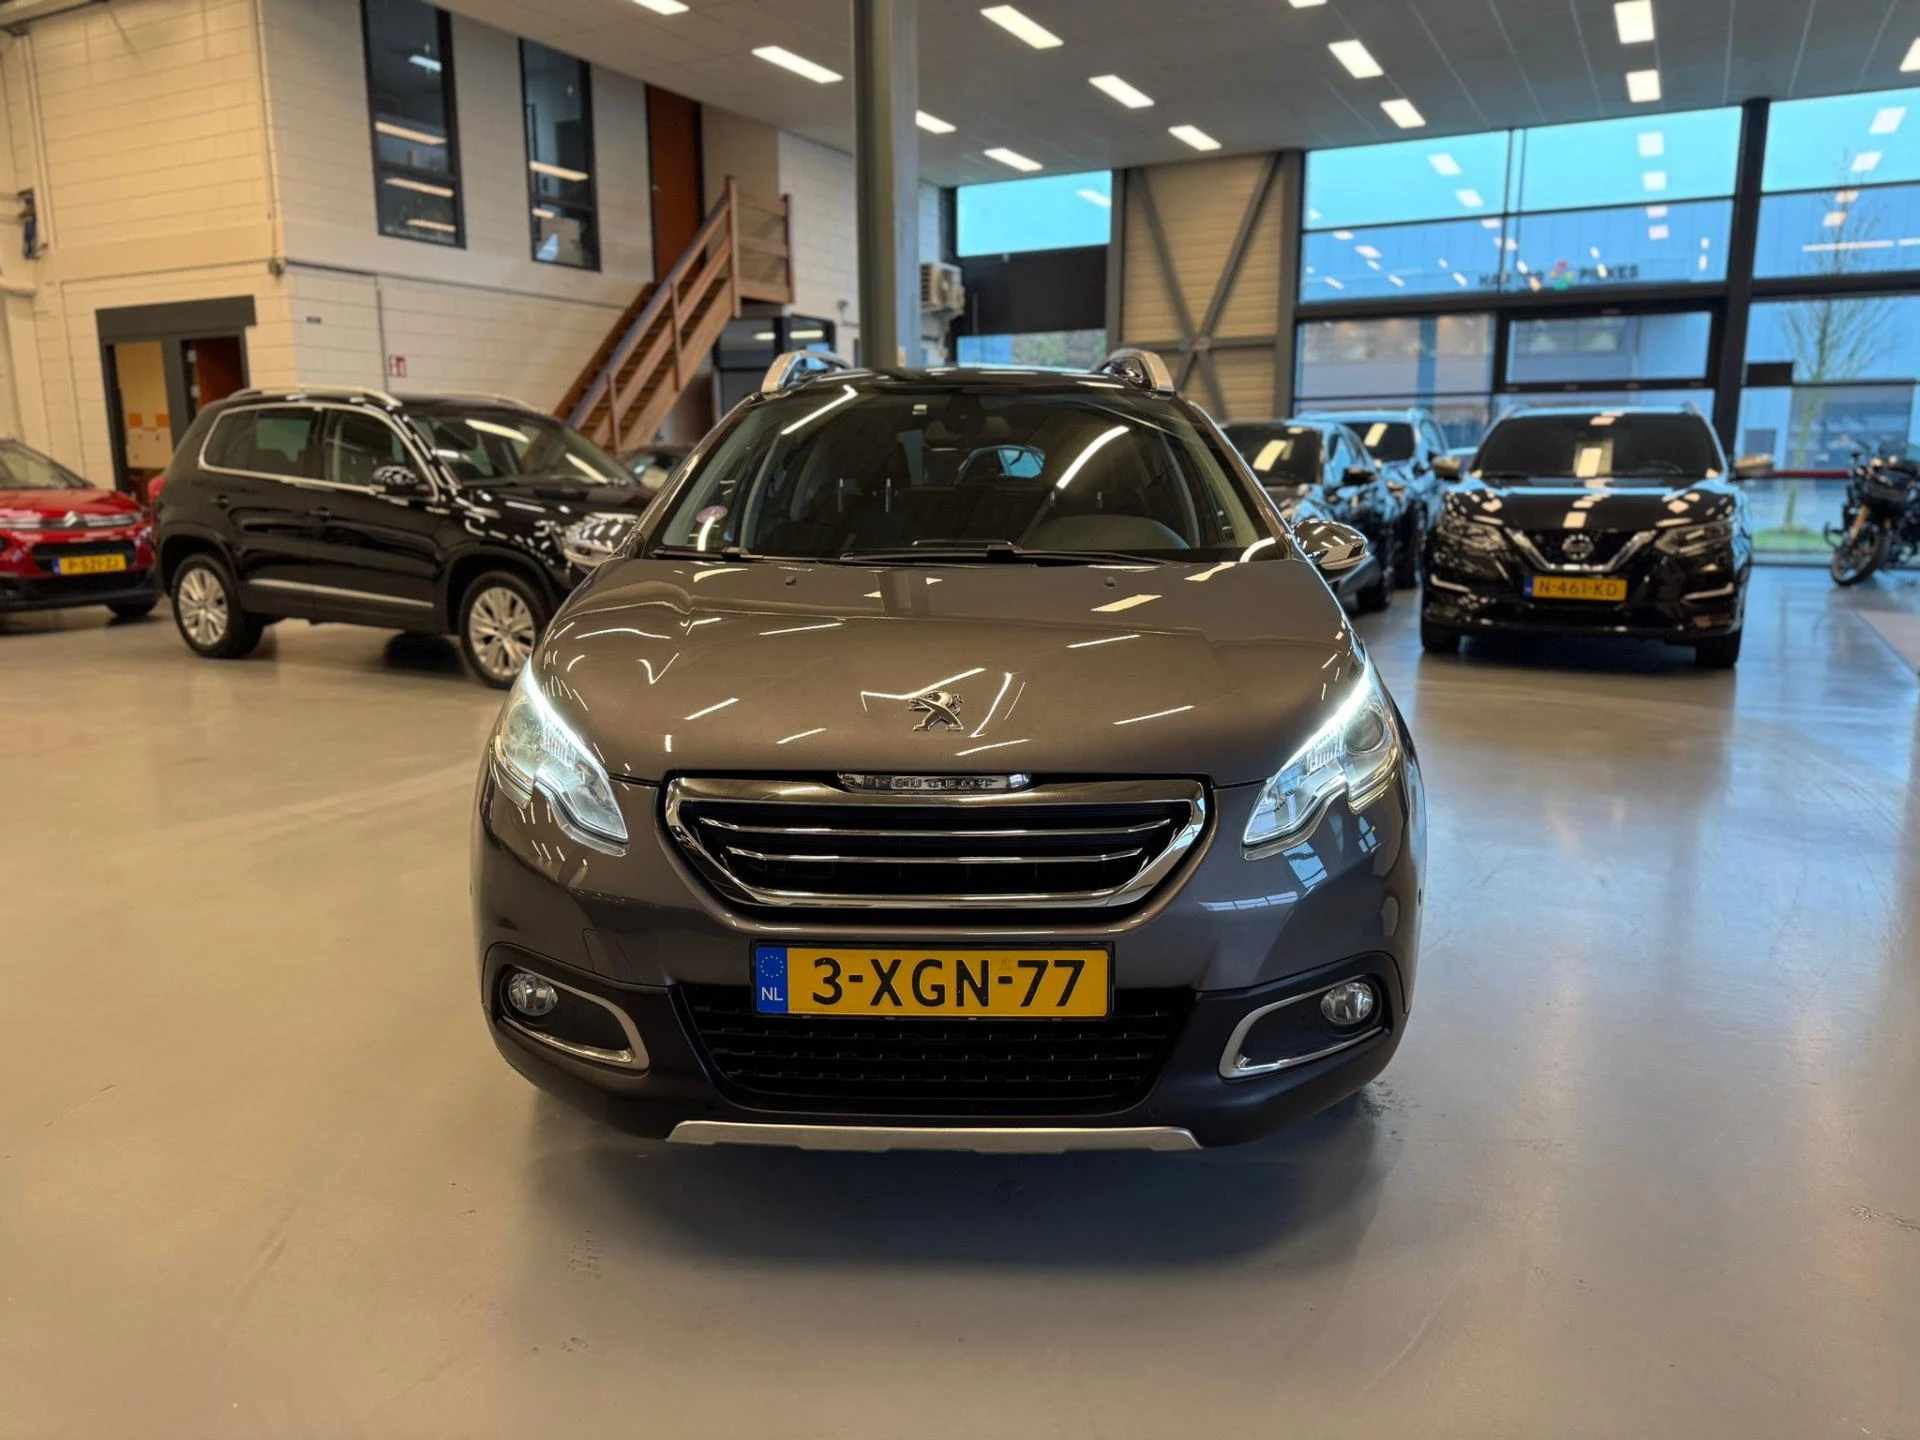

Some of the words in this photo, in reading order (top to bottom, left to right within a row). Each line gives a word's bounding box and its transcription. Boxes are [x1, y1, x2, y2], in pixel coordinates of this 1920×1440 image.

[1539, 580, 1618, 597] N-461-KD
[812, 956, 1086, 1007] 3-XGN-77
[761, 986, 784, 1001] NL
